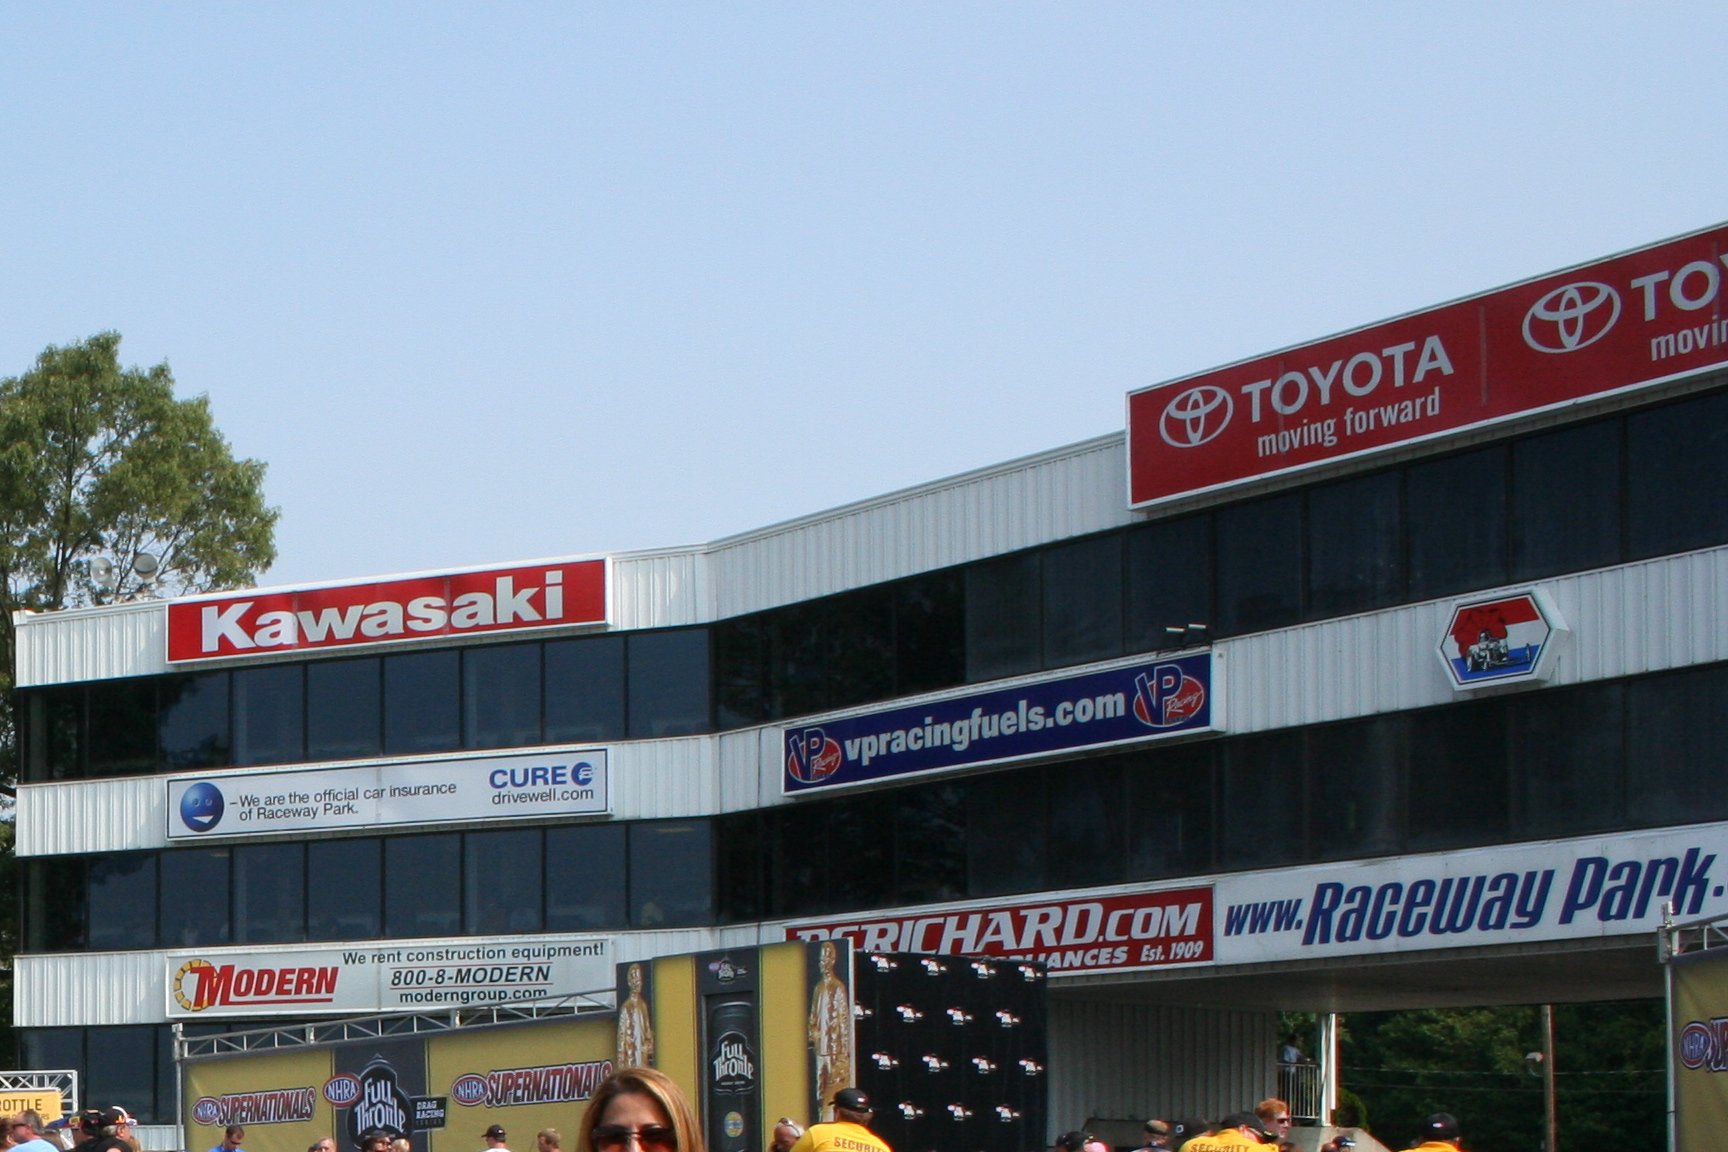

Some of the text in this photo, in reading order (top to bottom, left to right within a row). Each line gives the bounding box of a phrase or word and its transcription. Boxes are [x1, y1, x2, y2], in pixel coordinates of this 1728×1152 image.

[1631, 253, 1728, 321] TO
[1241, 335, 1454, 422] TOYOTA
[1257, 387, 1440, 458] moving forward
[201, 570, 563, 653] Kawasaki
[845, 692, 1125, 765] vpracingfuels.com
[489, 765, 567, 789] CURE
[239, 782, 456, 808] We are the official car insurance
[492, 787, 594, 805] drivewell.com
[239, 802, 358, 821] of Raceway Park.
[343, 942, 604, 965] We rent construction equipment!
[1140, 943, 1164, 962] Est.
[1169, 940, 1203, 961] 1909
[190, 964, 340, 1007] MODERN
[391, 965, 551, 986] 800-8-MODERN
[400, 987, 547, 1005] moderngroup.com
[326, 1080, 360, 1098] NHRA
[458, 1081, 484, 1099] NHRA
[195, 1087, 316, 1124] NHRA SUPERNATIONALS
